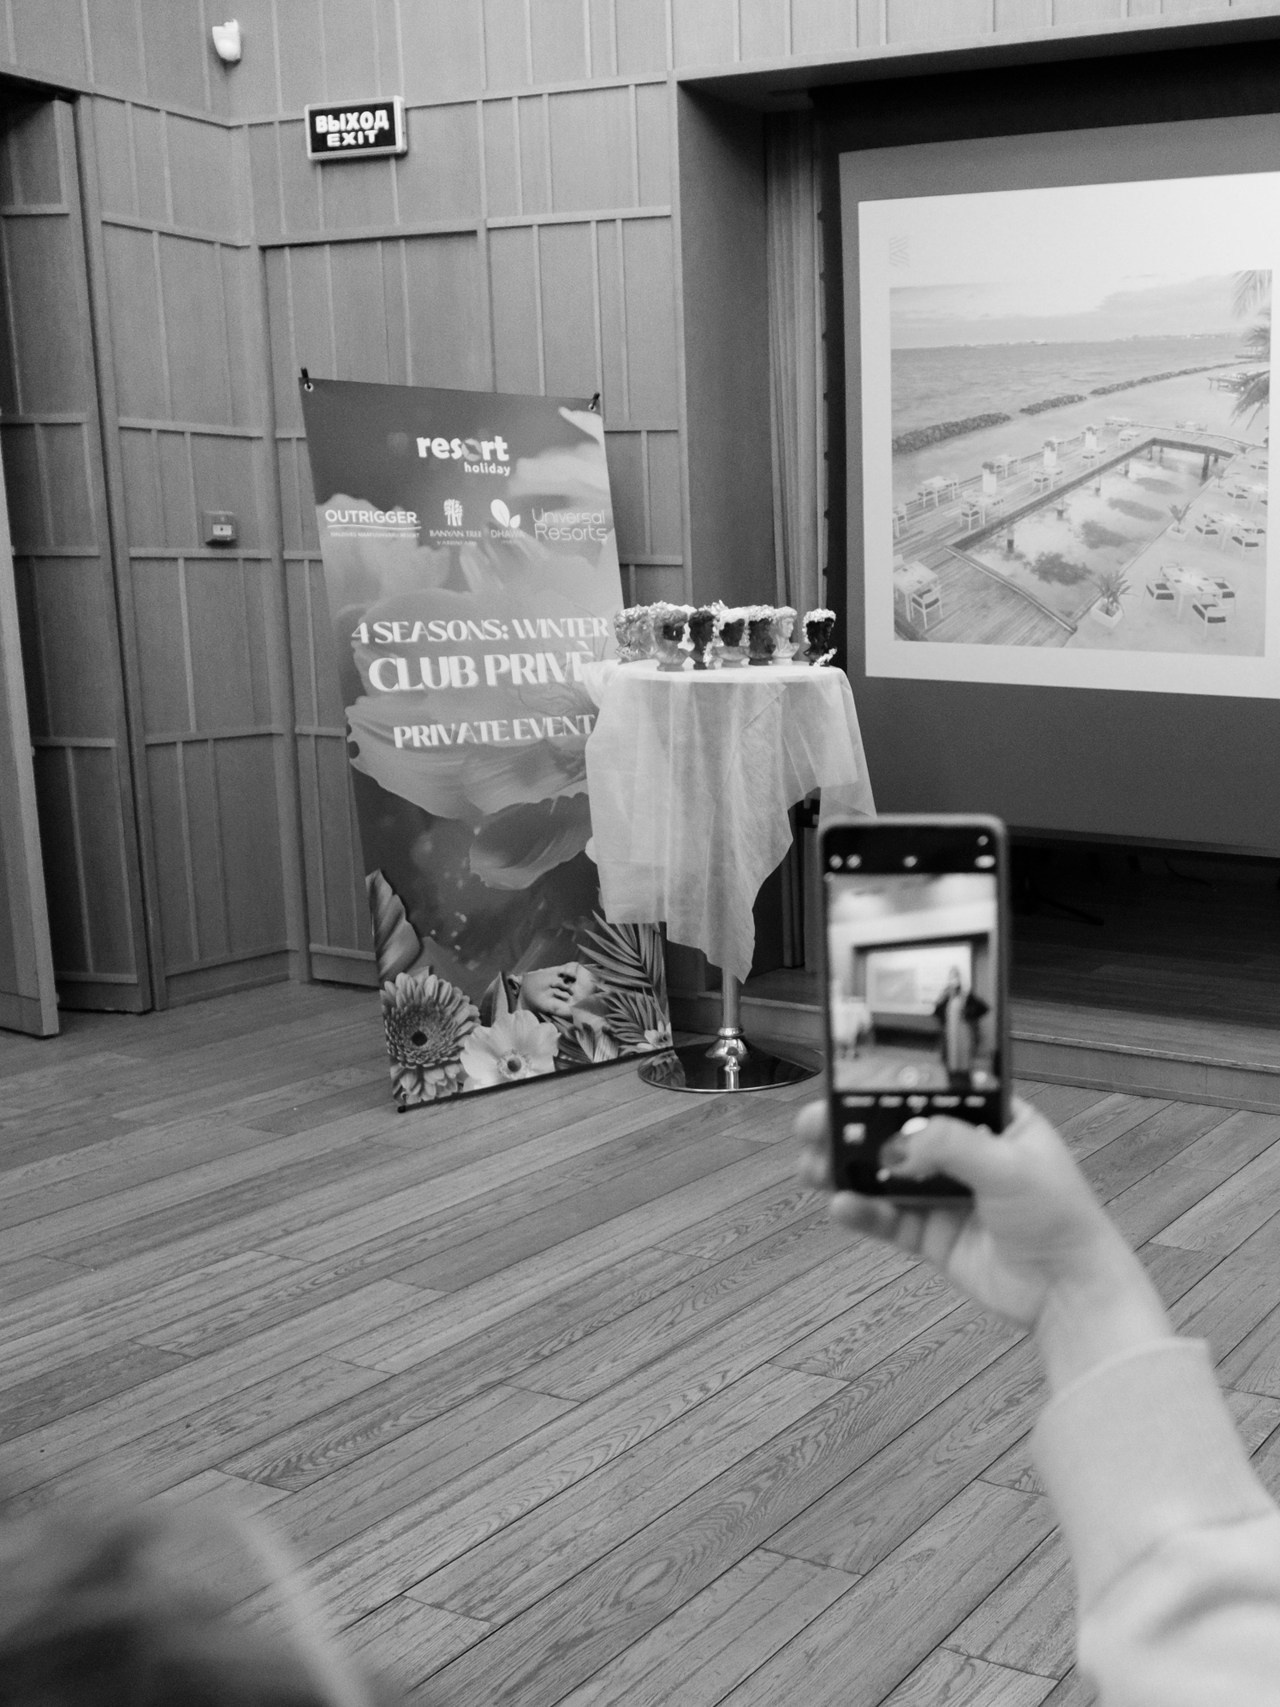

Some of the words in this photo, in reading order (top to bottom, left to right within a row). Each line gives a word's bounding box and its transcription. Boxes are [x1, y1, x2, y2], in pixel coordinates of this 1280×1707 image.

[315, 109, 390, 134] ВЫХОД
[327, 129, 378, 147] EXIT
[416, 435, 510, 461] resort
[464, 461, 511, 477] holiday
[325, 509, 418, 524] OUTRIGGER
[531, 507, 606, 524] Universal
[534, 522, 608, 541] Resorts
[351, 622, 370, 644] 4
[372, 618, 509, 644] SEASONS:
[511, 617, 609, 640] WINTER
[368, 655, 480, 692] CLUB
[393, 719, 511, 749] PRIVATE
[512, 714, 596, 741] EVENT
